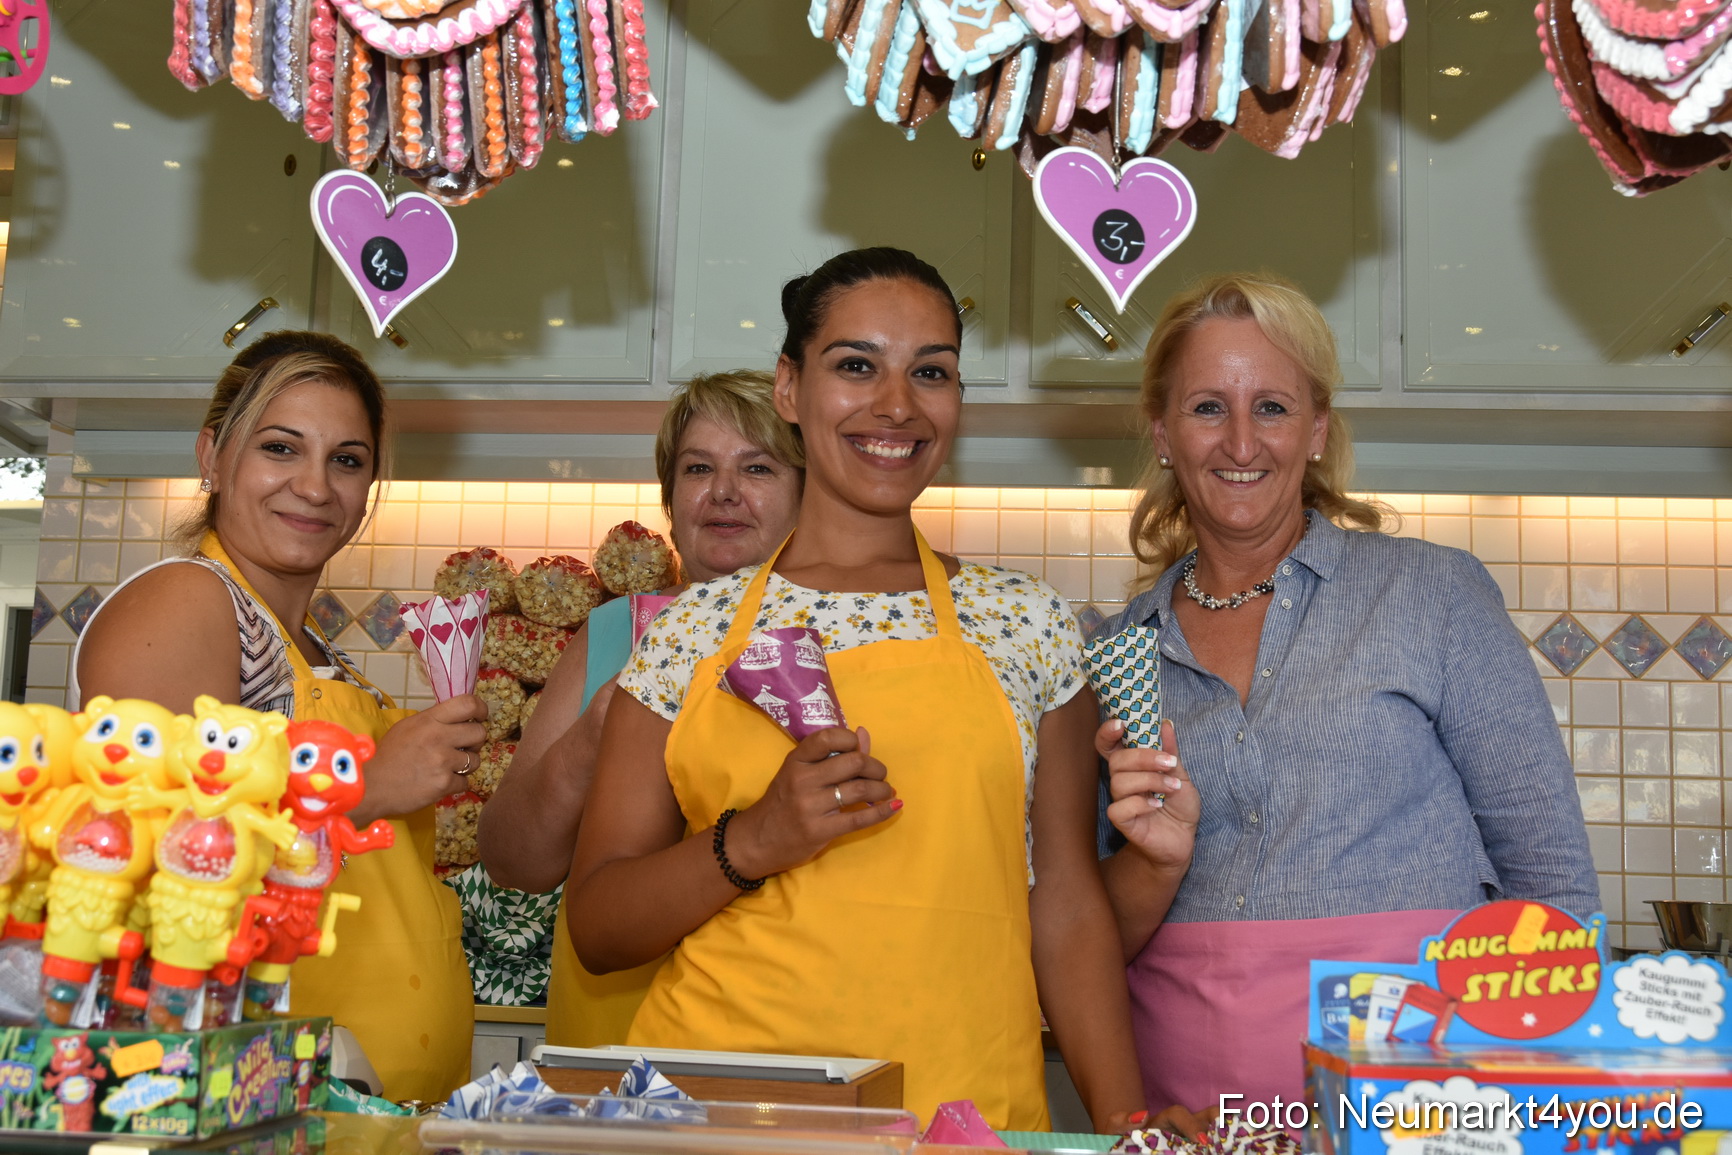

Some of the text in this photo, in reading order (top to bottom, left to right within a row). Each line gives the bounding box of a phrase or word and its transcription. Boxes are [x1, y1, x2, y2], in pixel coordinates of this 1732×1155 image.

[1115, 269, 1124, 279] €
[379, 295, 387, 306] €
[1425, 918, 1602, 961] KAUGMMi
[1639, 967, 1706, 989] Kaugummi
[1639, 980, 1702, 1002] Sticks mit
[1624, 991, 1712, 1016] Zauber-Rauch
[237, 1029, 273, 1083] Wild
[228, 1050, 291, 1124] Creatures
